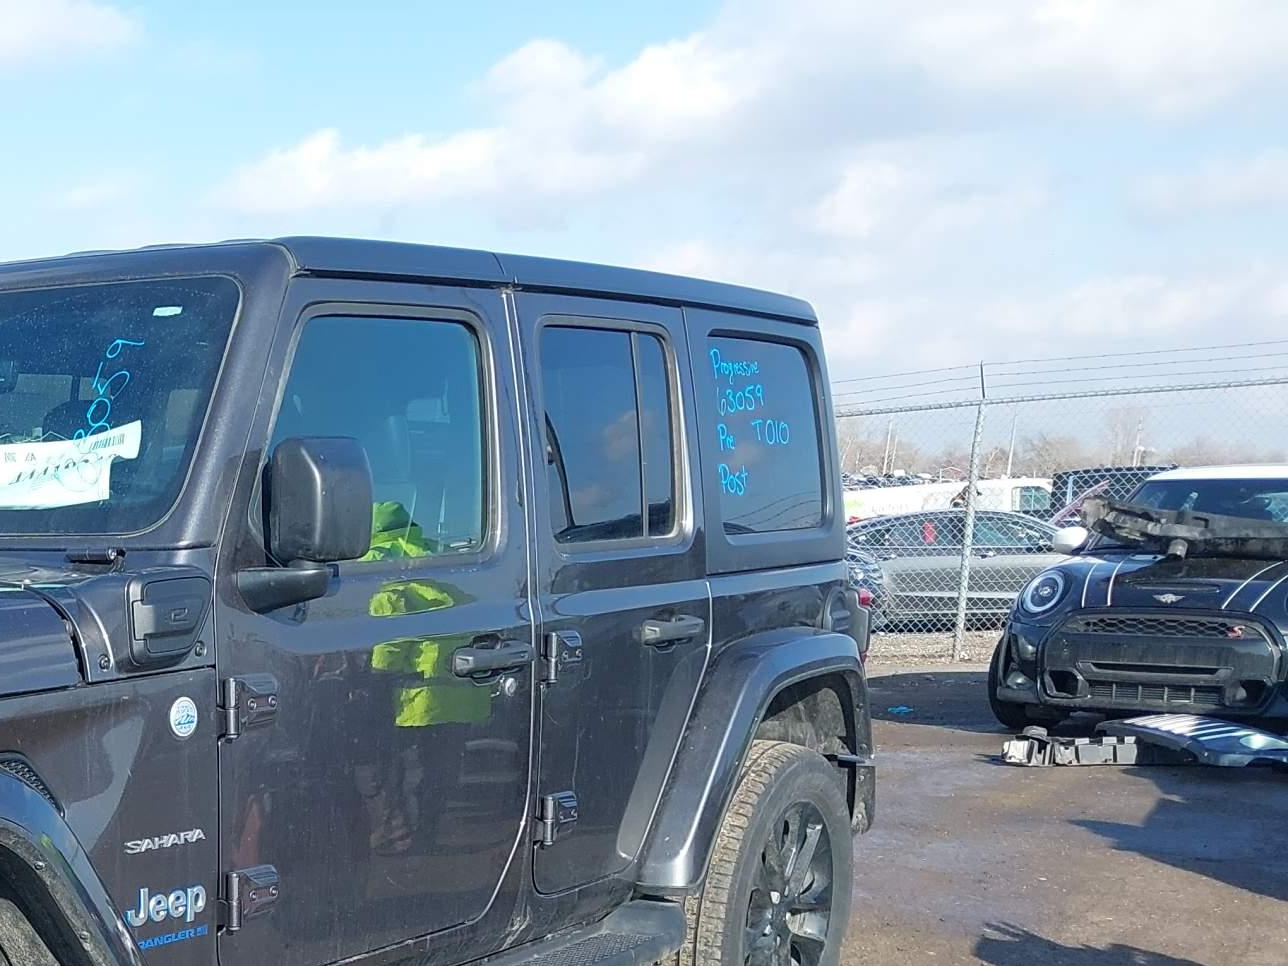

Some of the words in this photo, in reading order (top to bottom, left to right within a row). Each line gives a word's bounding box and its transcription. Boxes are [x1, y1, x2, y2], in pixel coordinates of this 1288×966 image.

[716, 385, 764, 416] 63059
[124, 828, 206, 854] SAHARA
[126, 884, 207, 928] Jeep
[137, 928, 196, 950] RANGLER
